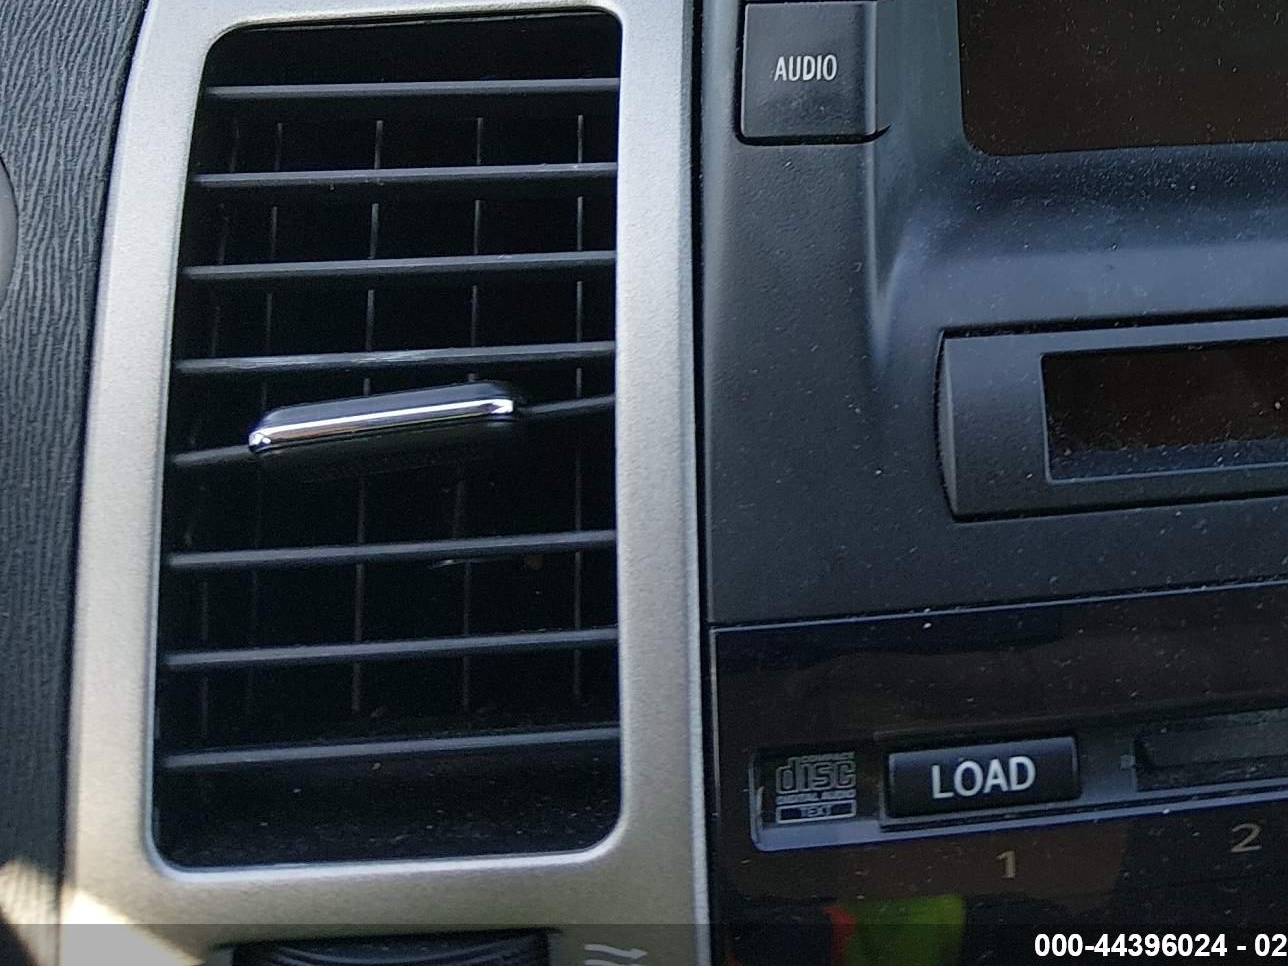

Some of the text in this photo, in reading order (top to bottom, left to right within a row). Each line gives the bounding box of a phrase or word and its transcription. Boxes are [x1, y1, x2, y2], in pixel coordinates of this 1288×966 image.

[773, 52, 838, 83] AUDIO
[931, 755, 1036, 800] LOAD
[996, 849, 1017, 879] 1
[1230, 823, 1263, 853] 2
